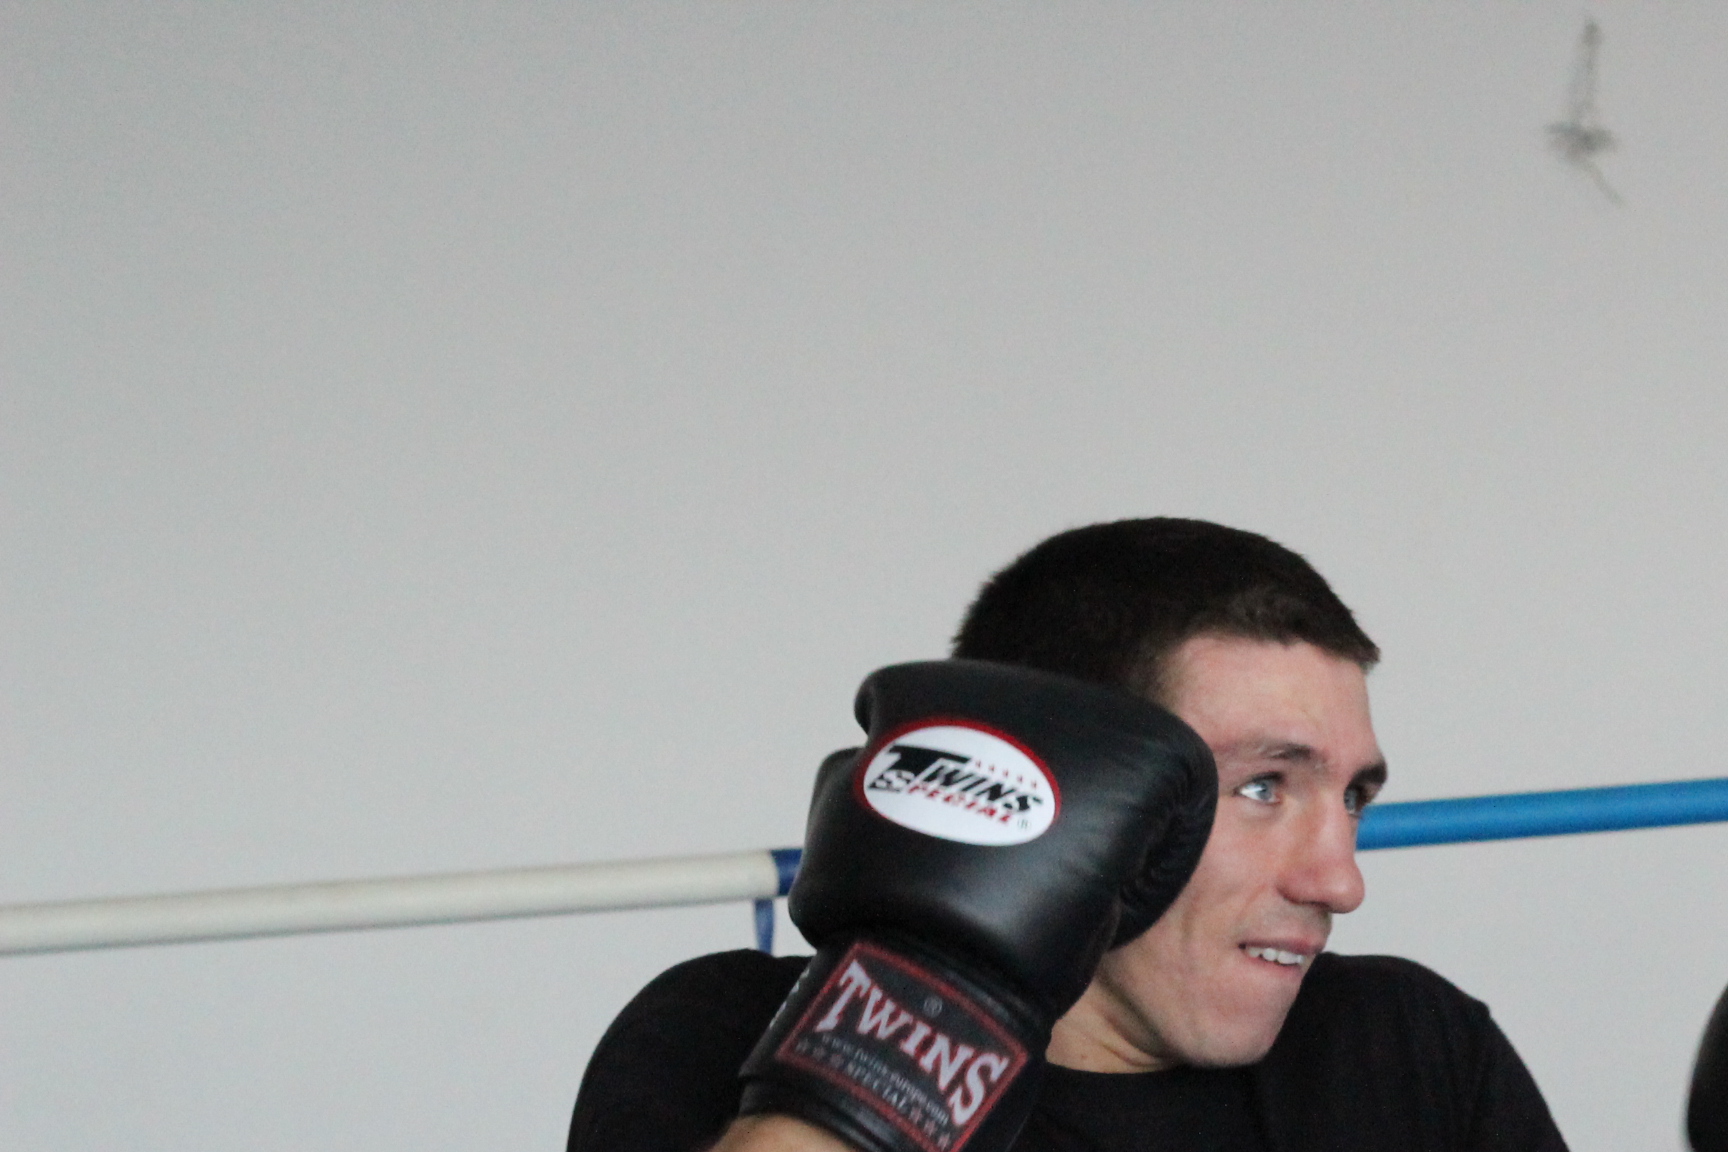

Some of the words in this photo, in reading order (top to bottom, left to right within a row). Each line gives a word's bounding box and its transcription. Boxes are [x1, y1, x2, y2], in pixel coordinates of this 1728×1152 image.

[869, 744, 1044, 813] TWINS
[871, 769, 1013, 824] SPECIAL
[814, 959, 1010, 1126] TWINS
[846, 1060, 908, 1112] SPECIAL
